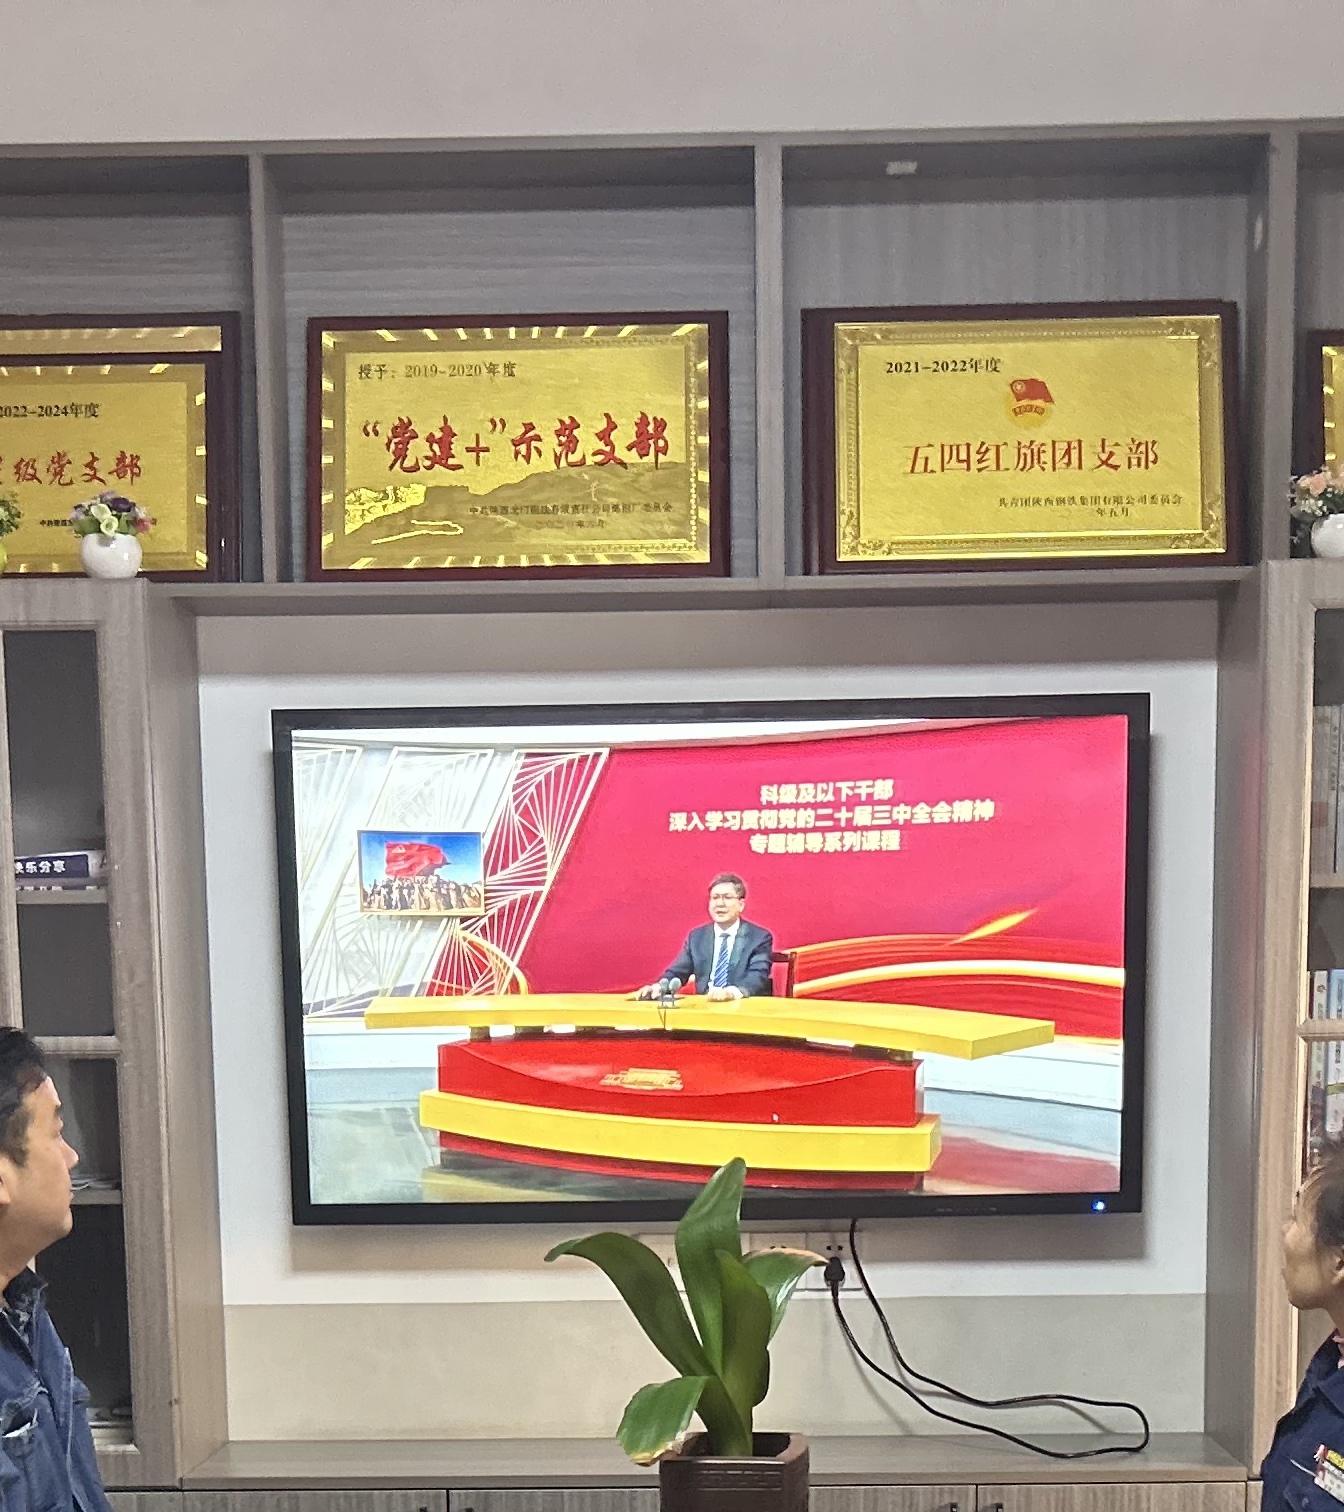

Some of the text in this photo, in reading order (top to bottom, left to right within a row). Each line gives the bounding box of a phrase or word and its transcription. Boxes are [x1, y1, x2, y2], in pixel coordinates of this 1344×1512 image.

[885, 357, 1002, 375] 2021-2022年度
[902, 436, 1160, 476] 五四红旗团支部
[759, 779, 895, 806] 科级及以下干部
[668, 799, 996, 832] 深入学习贯彻党的二十届三中全会精神
[749, 830, 902, 855] 专题辅导系列课程
